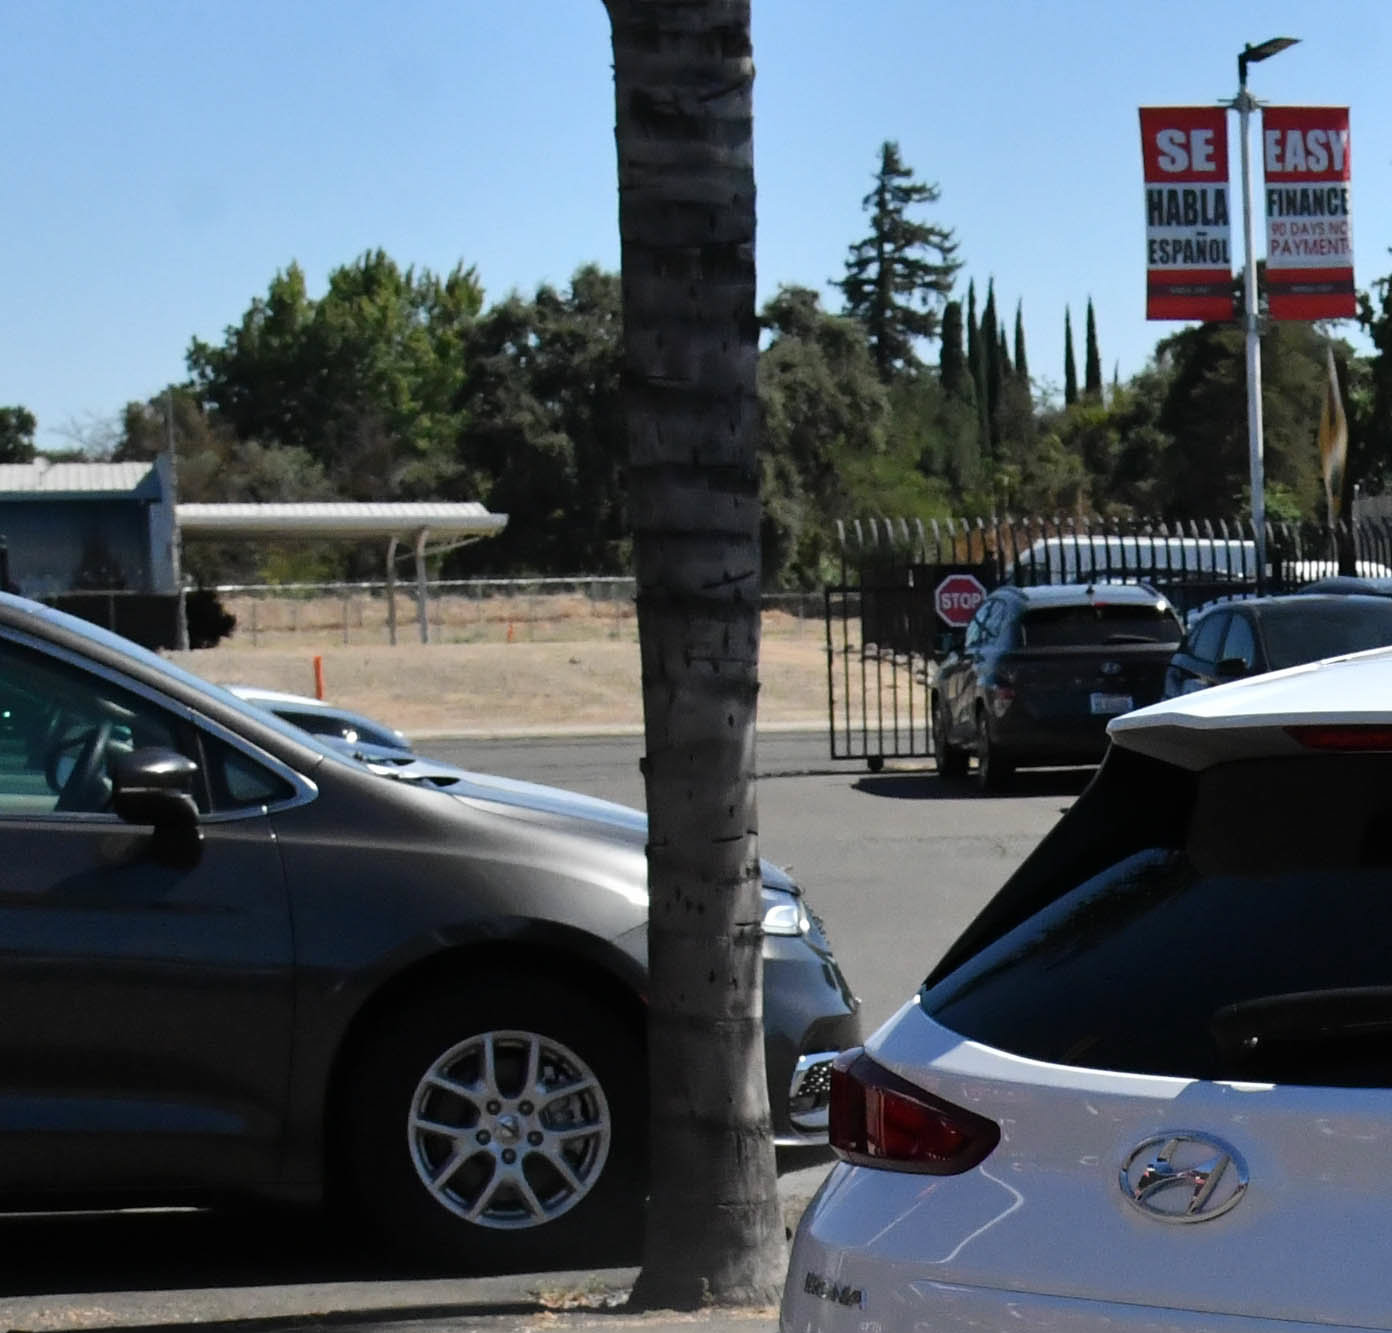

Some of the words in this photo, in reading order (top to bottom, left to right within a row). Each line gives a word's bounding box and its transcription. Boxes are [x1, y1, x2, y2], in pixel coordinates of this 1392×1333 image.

[1156, 129, 1216, 172] SE
[1265, 130, 1347, 171] EASY
[1148, 188, 1229, 226] HABLA
[1268, 187, 1348, 216] FINANCE
[1272, 222, 1286, 236] 90
[1291, 222, 1325, 235] DAYS
[1149, 231, 1230, 264] ESPAÑOL
[941, 592, 981, 609] STOP
